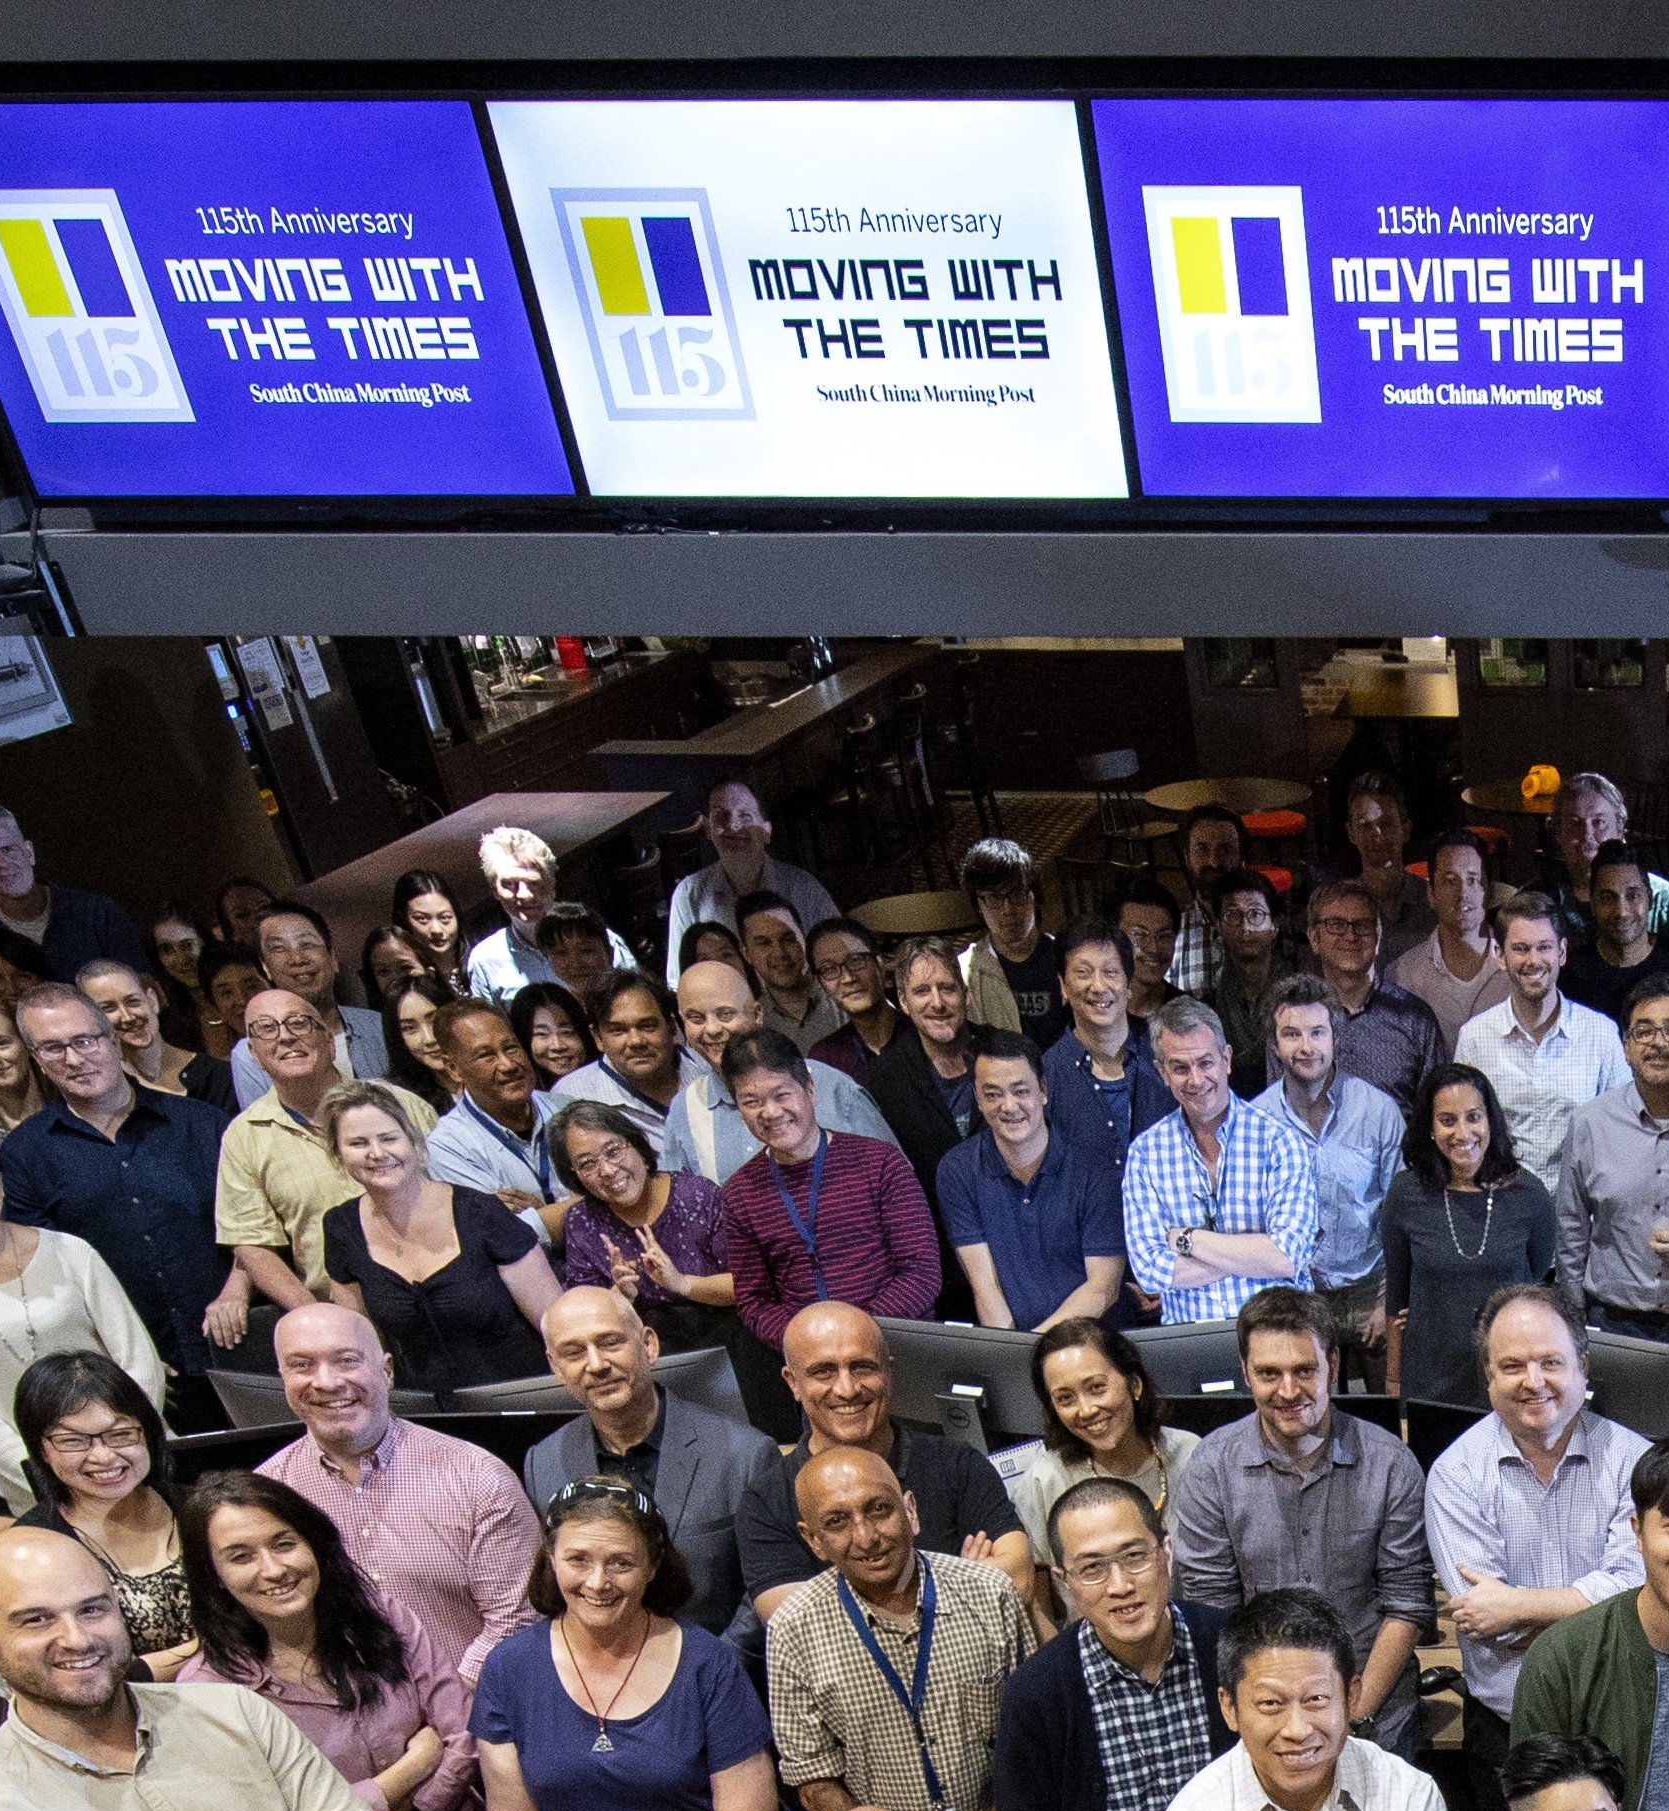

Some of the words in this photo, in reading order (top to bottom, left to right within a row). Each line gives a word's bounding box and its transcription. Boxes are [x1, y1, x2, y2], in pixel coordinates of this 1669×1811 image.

[196, 207, 264, 234] 115th
[271, 207, 412, 239] Anniversary
[787, 207, 851, 233] 115th
[860, 208, 1001, 239] Anniversary
[1377, 206, 1440, 234] 115th
[1449, 207, 1593, 241] Anniversary
[165, 259, 352, 301] MOVING
[364, 258, 484, 301] WITH
[749, 260, 929, 300] MOVING
[948, 260, 1062, 300] WITH
[1332, 258, 1510, 302] MOVING
[1532, 259, 1643, 303] WITH
[207, 318, 315, 359] THE
[327, 318, 479, 359] TIMES
[783, 319, 885, 358] THE
[907, 320, 1049, 359] TIMES
[1358, 318, 1458, 361] THE
[1480, 319, 1623, 362] TIMES
[250, 383, 303, 402] South
[303, 383, 357, 403] China
[356, 383, 433, 407] Morning
[431, 384, 471, 402] Post
[817, 385, 867, 401] South
[870, 385, 921, 402] China
[924, 385, 997, 406] Morning
[999, 386, 1034, 402] Post
[1383, 384, 1434, 404] South
[1436, 384, 1488, 405] China
[1491, 385, 1564, 410] Morning
[1566, 385, 1603, 405] Post
